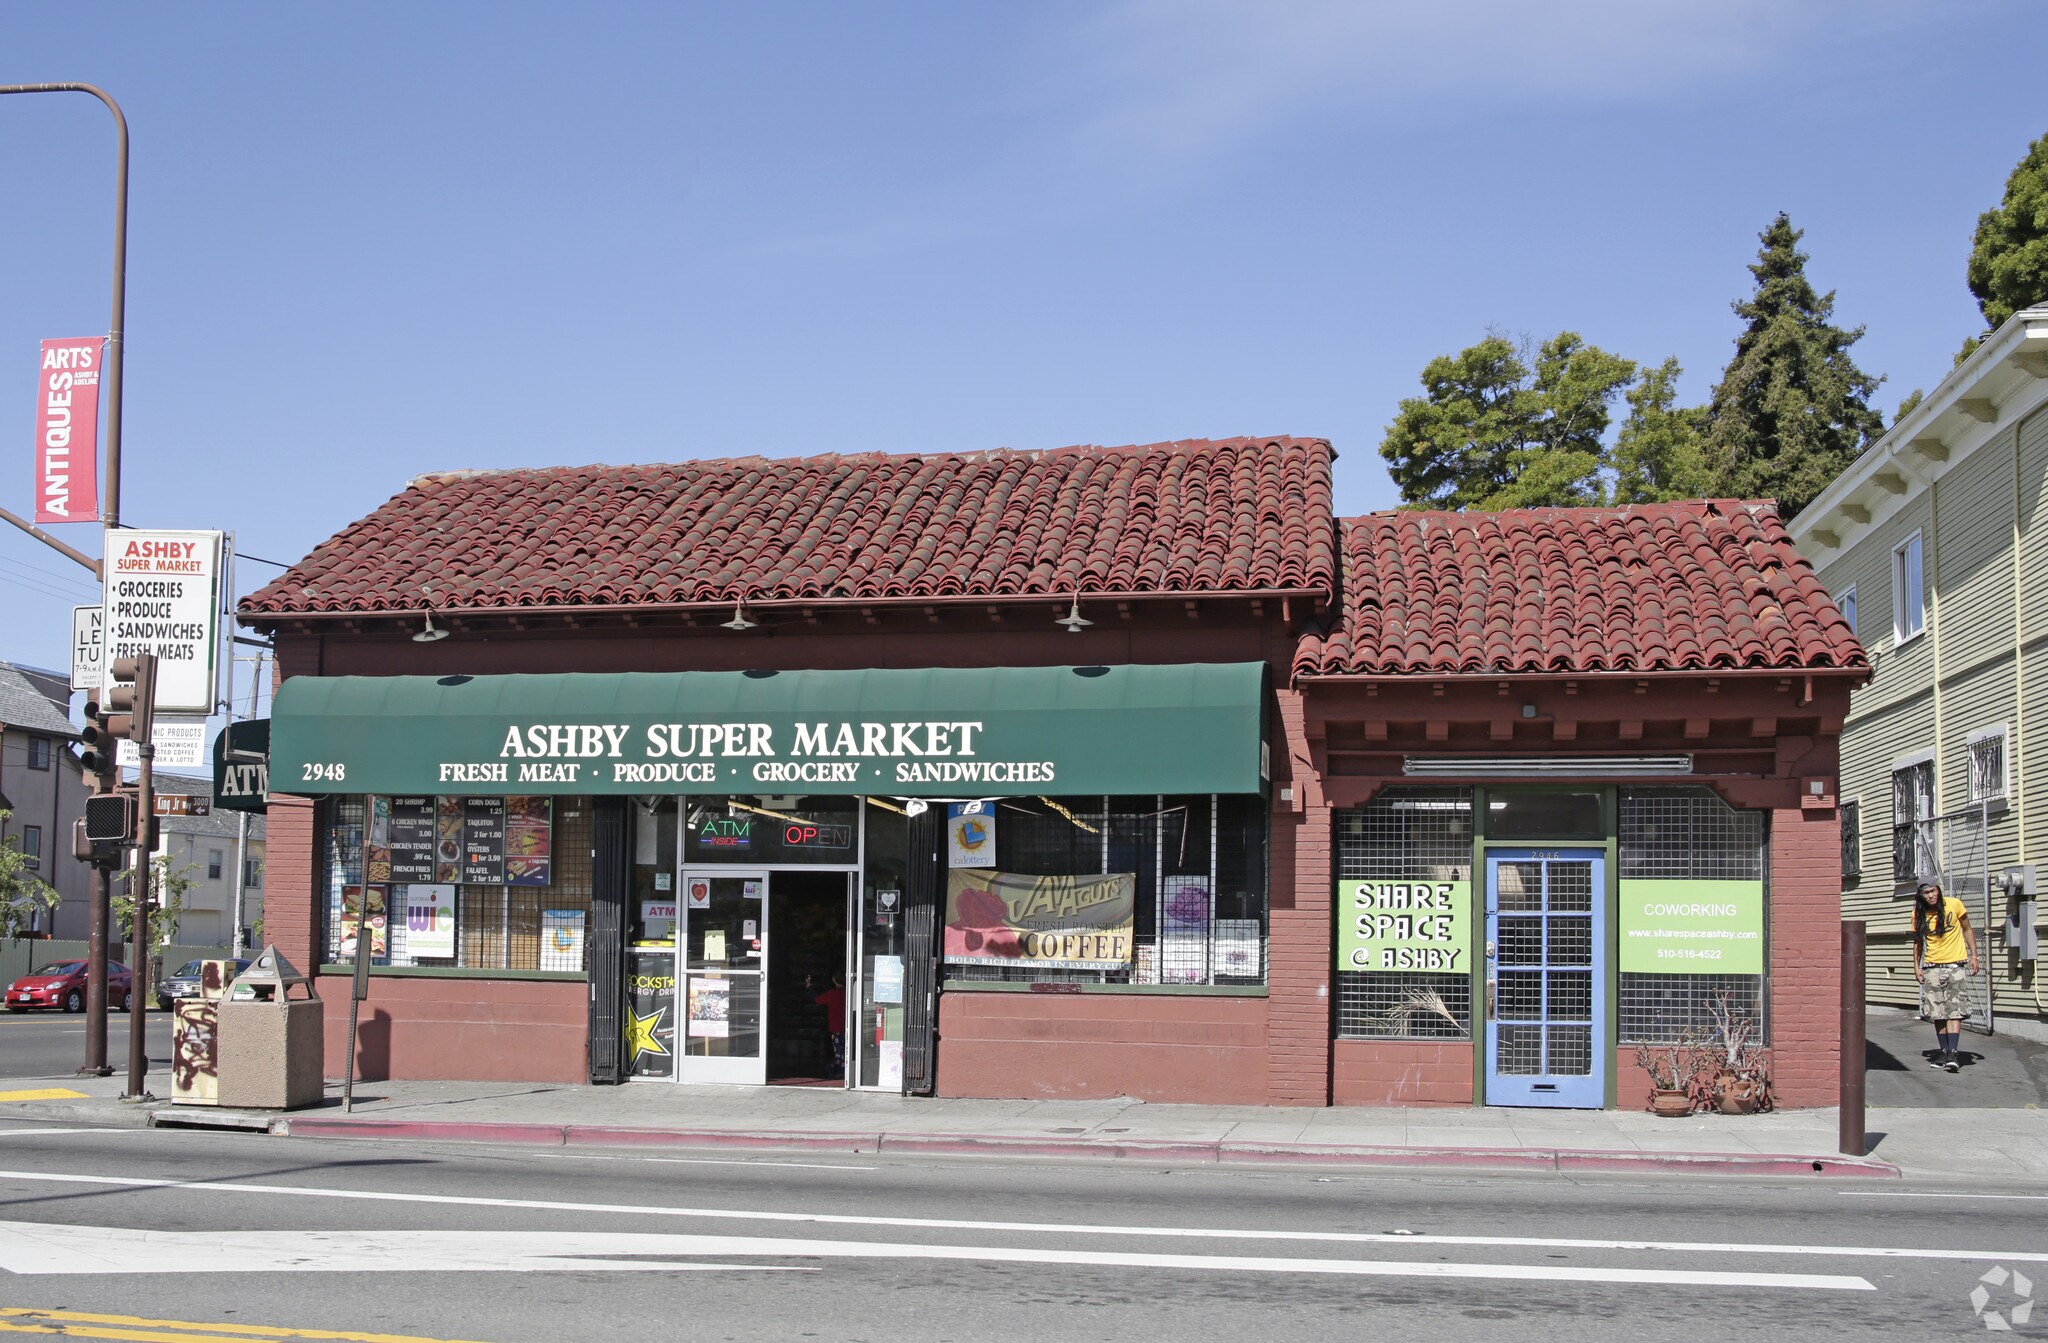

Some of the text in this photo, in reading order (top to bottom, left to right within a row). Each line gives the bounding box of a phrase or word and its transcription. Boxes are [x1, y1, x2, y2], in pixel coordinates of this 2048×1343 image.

[43, 347, 93, 369] ARTS
[73, 378, 98, 386] ADELINE
[45, 371, 73, 517] ANTIQUES
[125, 540, 196, 559] ASHBY
[117, 558, 202, 572] SUPER MARKET
[119, 580, 183, 599] GROCERIES
[117, 602, 171, 619] PRODUCE
[80, 630, 101, 645] LE
[117, 622, 204, 640] SANDWICHES
[77, 647, 99, 662] TU
[157, 645, 194, 661] MEATS
[168, 728, 202, 737] PRODUCTS
[500, 721, 983, 758] ASHBY SUPER MARKET
[302, 763, 345, 781] 2948
[439, 761, 1055, 783] FRESH MEAT PRODUCE GROCERY SANDWICHES
[157, 796, 170, 814] King
[173, 797, 180, 810] Jr
[194, 797, 209, 806] 3000
[468, 798, 484, 806] CORN
[420, 806, 433, 814] 3.99
[418, 818, 433, 826] WINGS
[467, 819, 494, 827] TAQUITOS
[701, 820, 749, 836] ATM
[418, 830, 432, 838] 3.00
[711, 836, 739, 846] INSIDE
[786, 826, 847, 845] OPEN
[390, 842, 412, 850] CHICKEN
[467, 845, 490, 853] OYSTERS
[487, 854, 501, 862] 3.99
[953, 855, 990, 866] calottery
[1531, 852, 1560, 861] 2946
[393, 865, 415, 873] FRENCH
[1354, 883, 1454, 911] SHARE
[649, 907, 675, 916] ATM
[1644, 903, 1737, 917] COWORKING
[408, 906, 453, 932] wic
[1027, 921, 1126, 934] FRESH ROASTED
[1354, 914, 1454, 941] SPACE
[1627, 928, 1758, 941] www.sharespaceashby.com
[1024, 933, 1126, 959] COFFEE
[1349, 946, 1461, 970] @ ASHBY
[1656, 948, 1723, 960] 510-516-4522
[1011, 959, 1051, 967] FLAVOR
